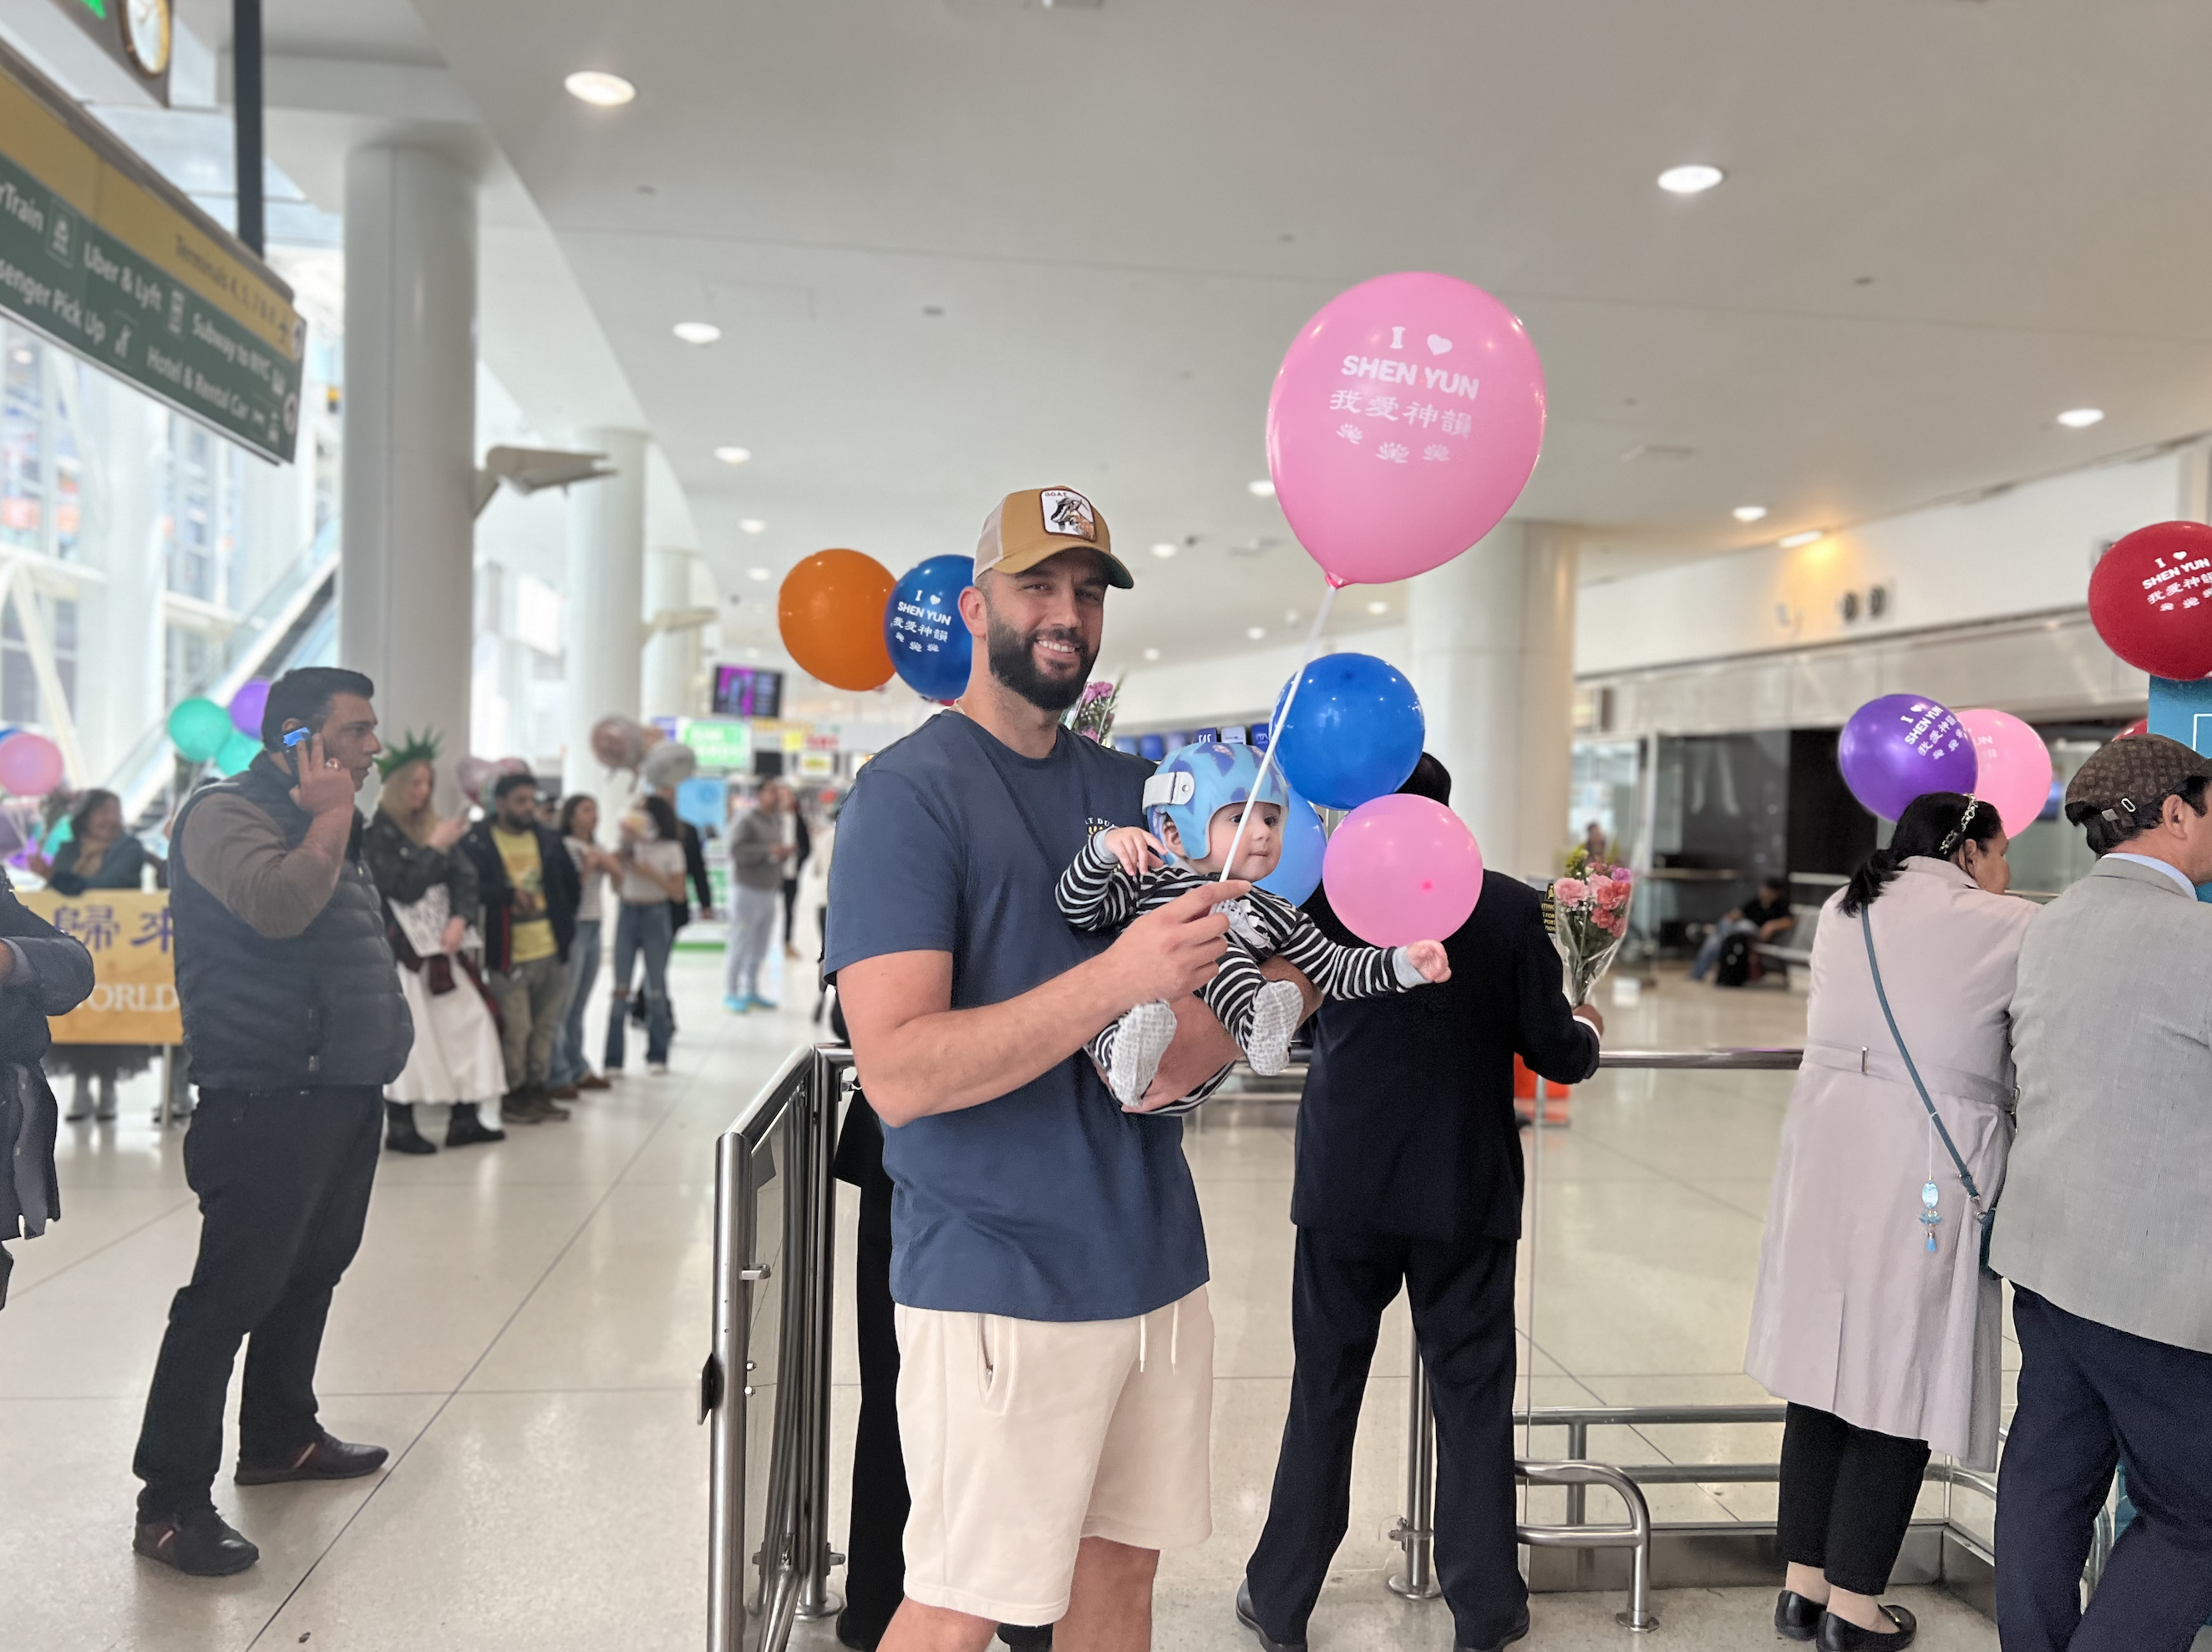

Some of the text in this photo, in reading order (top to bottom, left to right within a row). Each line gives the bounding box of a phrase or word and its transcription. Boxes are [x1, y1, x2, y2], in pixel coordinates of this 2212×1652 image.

[84, 241, 119, 283] Uber
[121, 266, 134, 295] &
[134, 273, 163, 312] Lyft
[192, 312, 236, 363] Subway
[1389, 326, 1405, 349] I
[53, 288, 82, 330] Pick
[84, 308, 106, 346] Up
[147, 344, 183, 384] Hotel
[194, 372, 231, 411] Rental
[231, 393, 250, 419] Car
[1341, 355, 1479, 400] SHEN YUN
[1330, 389, 1473, 438] 我愛神韻
[2142, 558, 2210, 590] SHEN YUN
[2154, 557, 2166, 568] I
[915, 590, 923, 601] I
[893, 616, 948, 642] 我愛神韻
[897, 601, 951, 626] SHEN YUN
[1900, 715, 1914, 723] I
[1905, 705, 1944, 745] SHEN YUN
[77, 982, 180, 1013] ORLD
